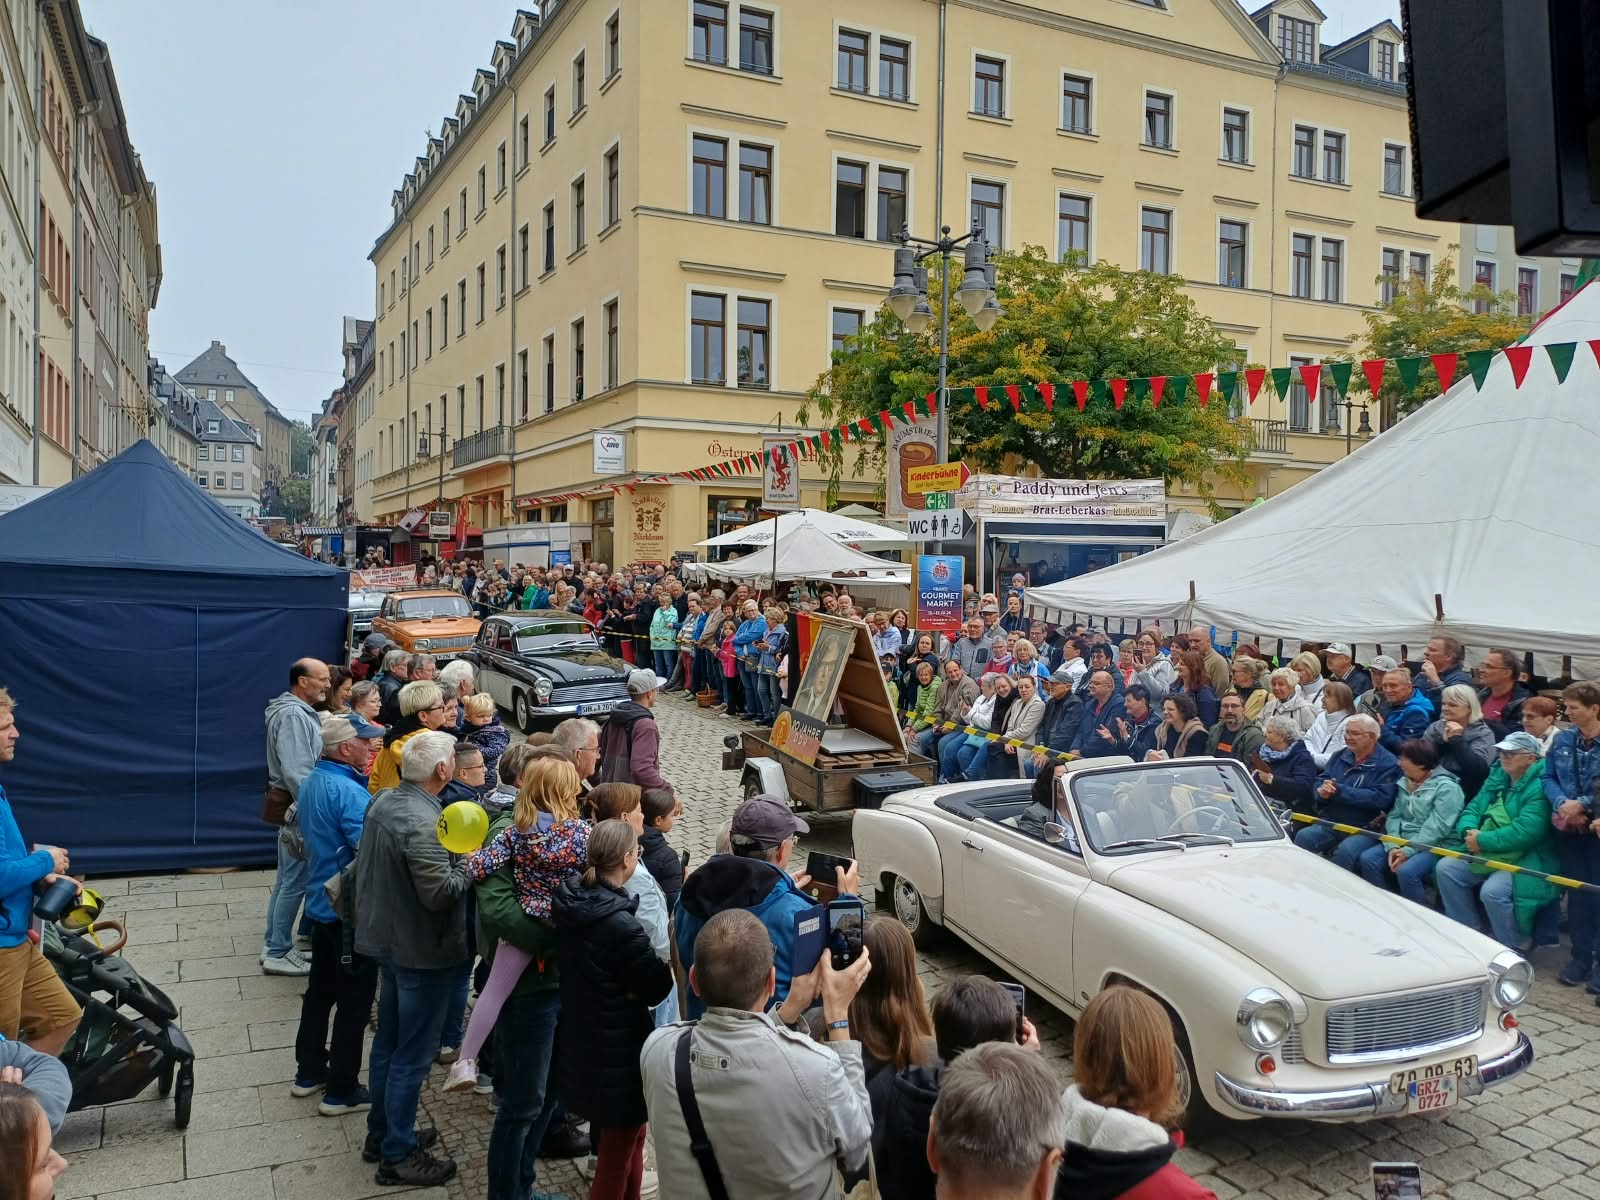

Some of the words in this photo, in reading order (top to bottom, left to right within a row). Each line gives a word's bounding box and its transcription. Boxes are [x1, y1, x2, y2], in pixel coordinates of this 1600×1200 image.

[892, 426, 938, 452] BAUMSTRIEZ
[911, 467, 959, 481] Kinderbühne
[1013, 481, 1057, 498] Paddy
[1062, 483, 1090, 496] und
[1095, 484, 1128, 499] Jen's
[1032, 505, 1106, 515] Brat-Leberkas
[909, 520, 928, 534] WC
[926, 600, 955, 608] MARKT
[800, 723, 821, 741] JAHRE
[1417, 1080, 1440, 1097] GRZ
[1418, 1092, 1449, 1110] 0727
